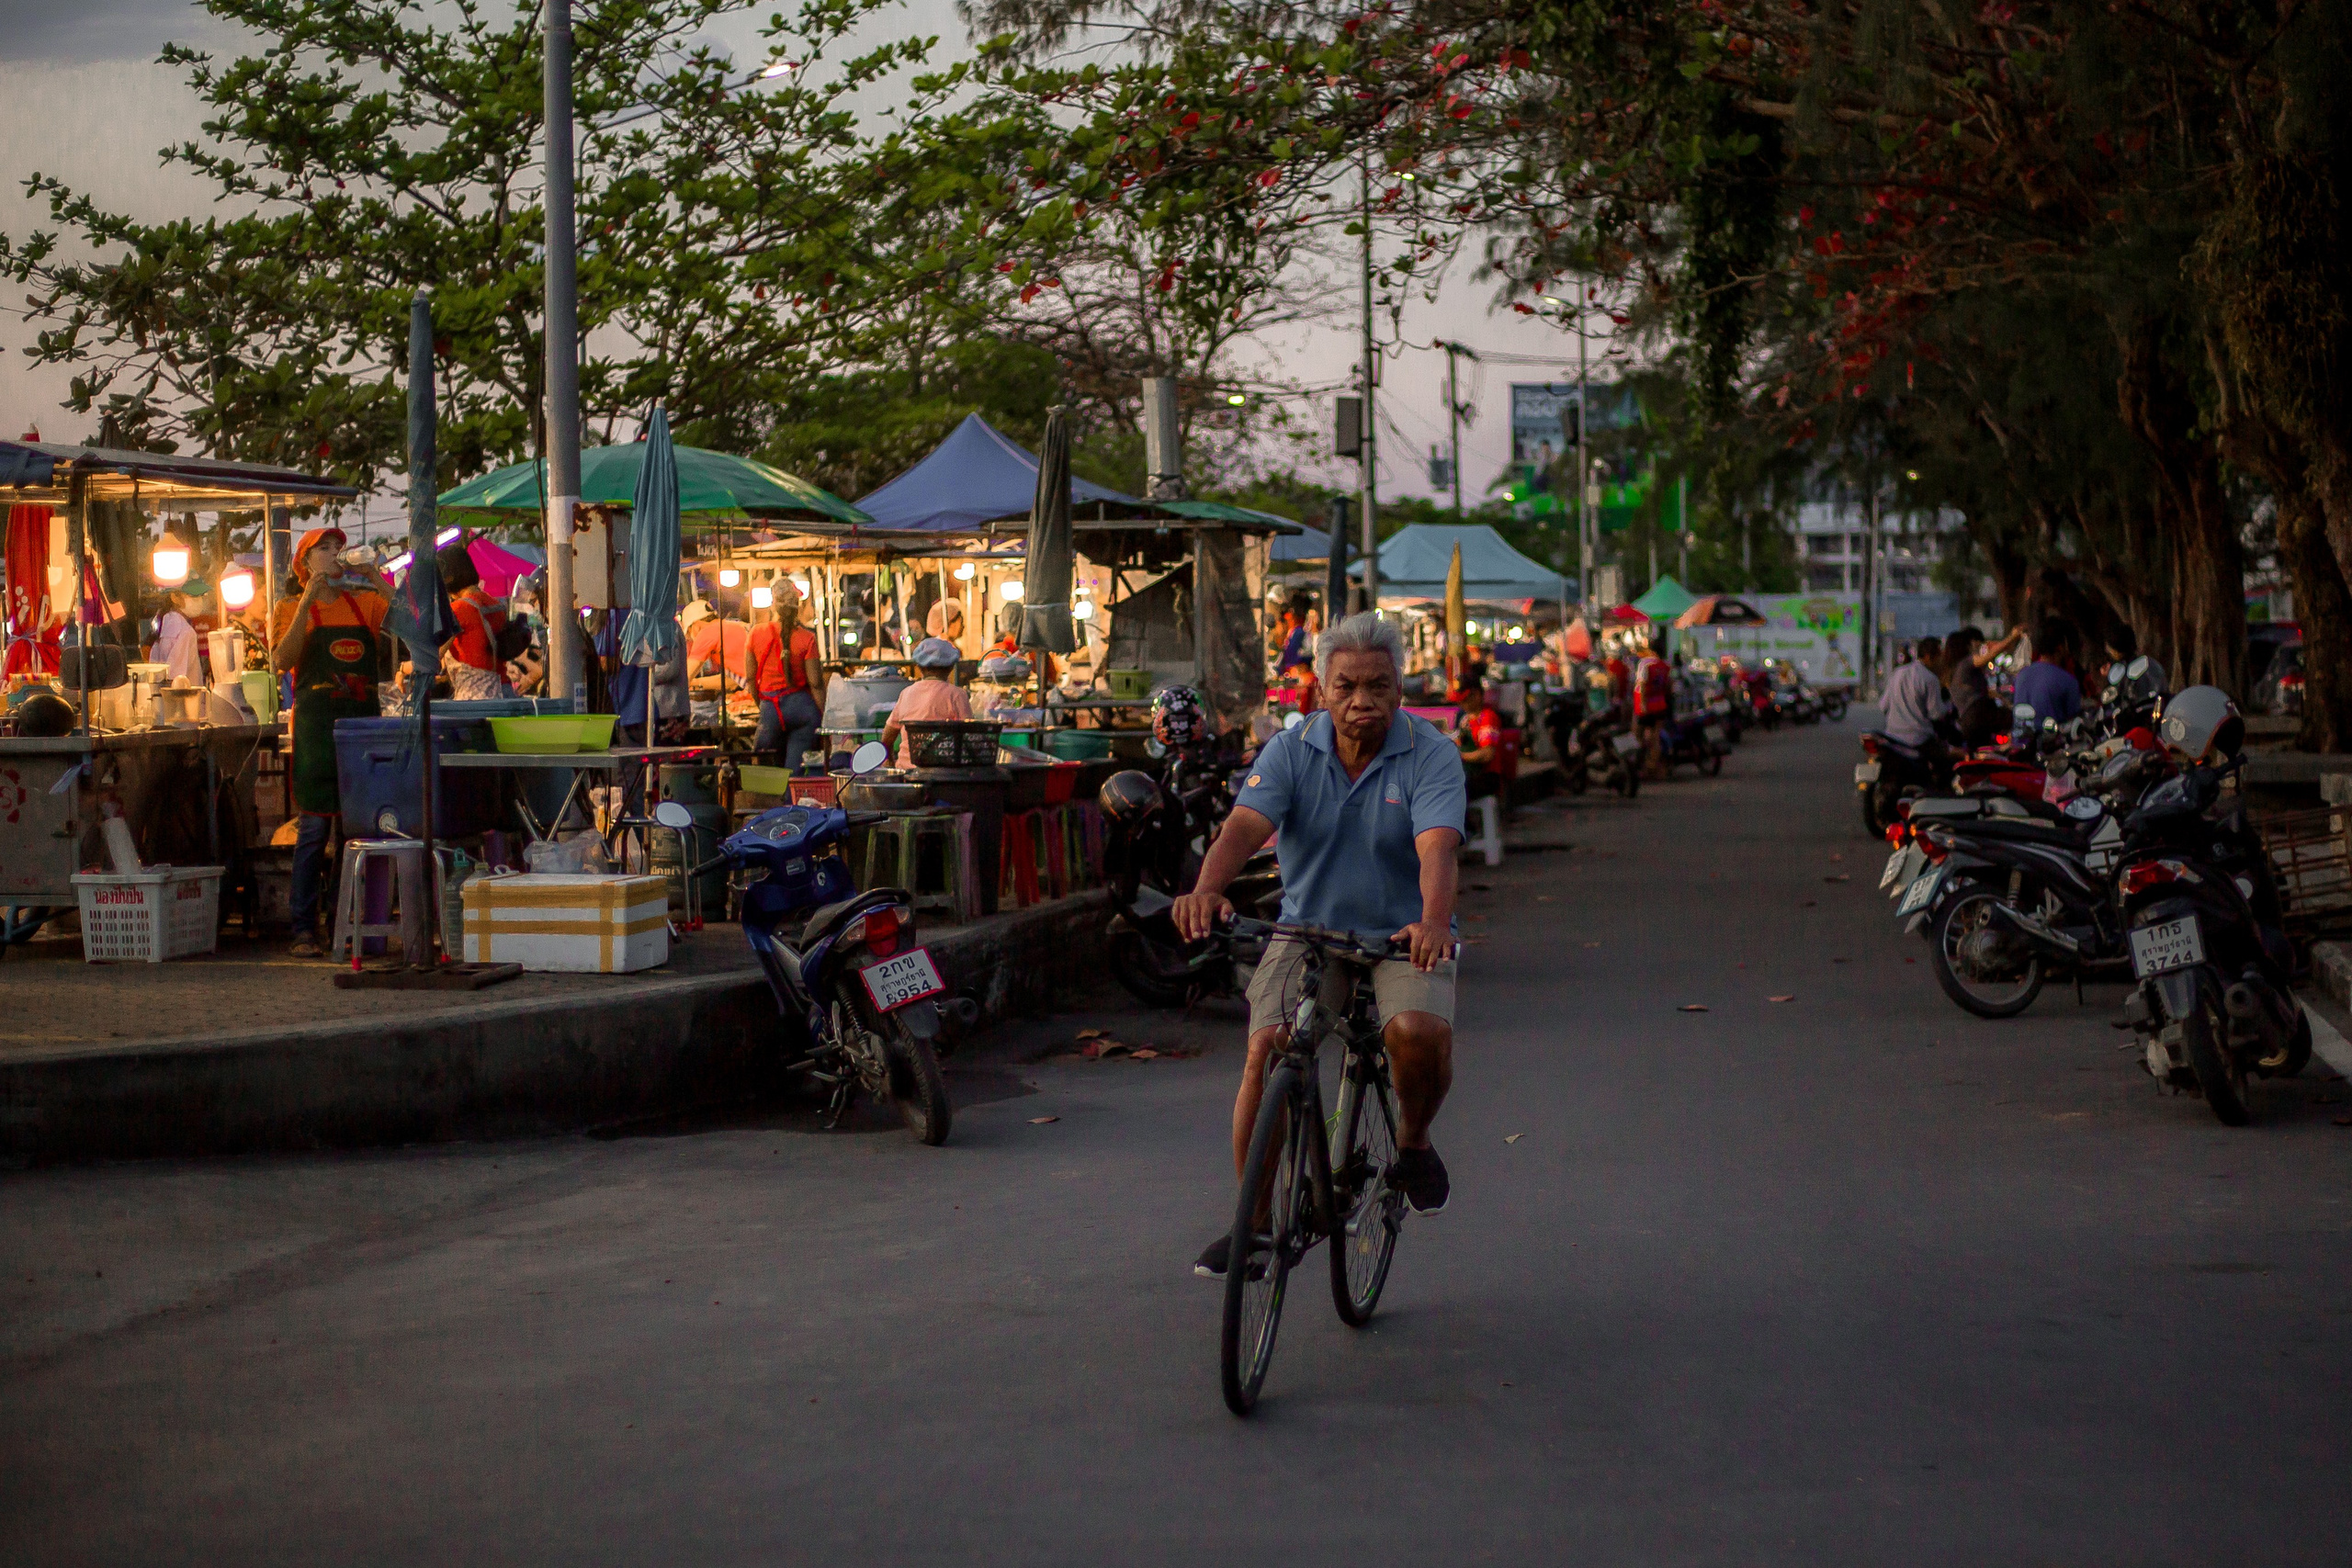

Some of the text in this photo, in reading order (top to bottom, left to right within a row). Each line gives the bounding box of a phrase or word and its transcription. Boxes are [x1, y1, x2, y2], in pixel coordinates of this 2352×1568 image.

[2147, 921, 2182, 942] 1กธ
[878, 956, 916, 978] 2กข
[2146, 950, 2193, 973] 3744
[886, 979, 932, 1005] 8954
